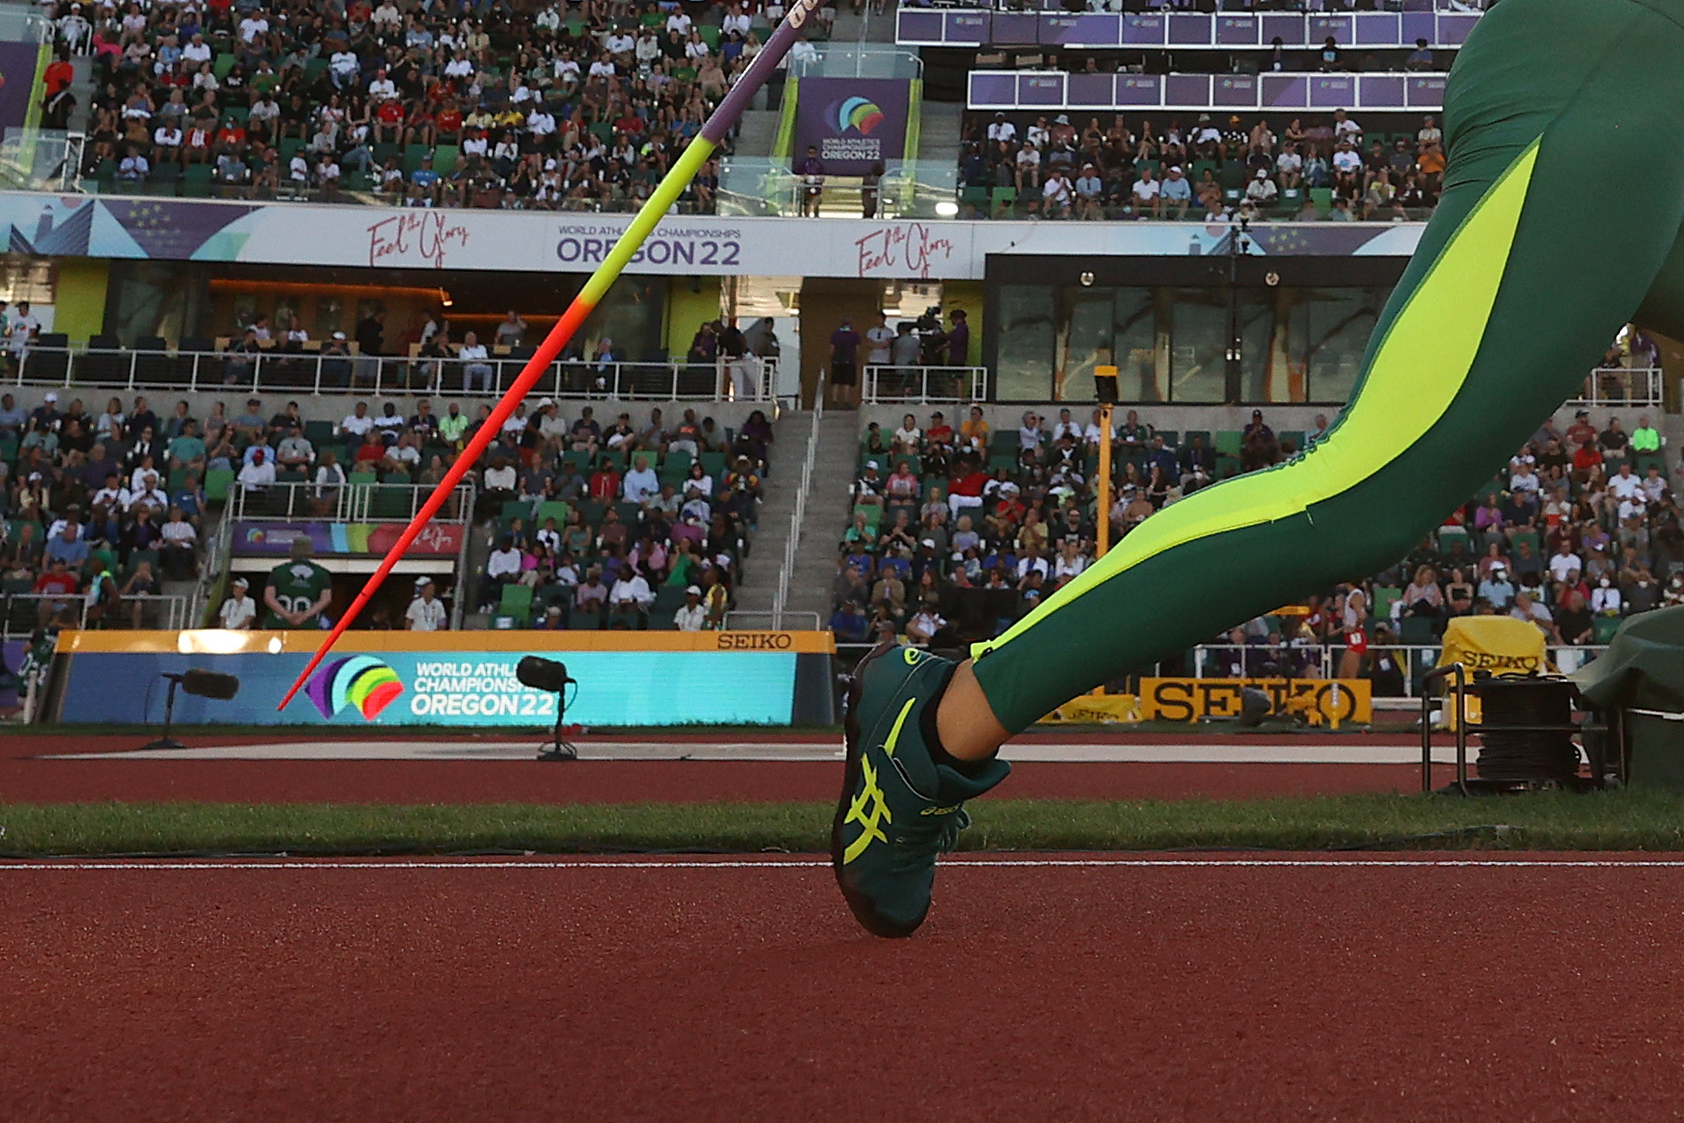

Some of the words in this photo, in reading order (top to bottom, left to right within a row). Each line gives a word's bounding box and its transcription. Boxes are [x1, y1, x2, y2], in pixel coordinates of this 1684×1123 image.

[559, 225, 597, 235] WORLD
[599, 226, 655, 237] ATHLS
[658, 228, 741, 238] CHAMPIONSHIPS
[718, 633, 792, 650] SEIKO
[1462, 650, 1538, 670] SEIKO
[416, 662, 472, 677] WORLD
[414, 677, 545, 693] CHAMPIONS
[410, 693, 555, 716] OREGON22
[1154, 682, 1356, 723] SEKO
